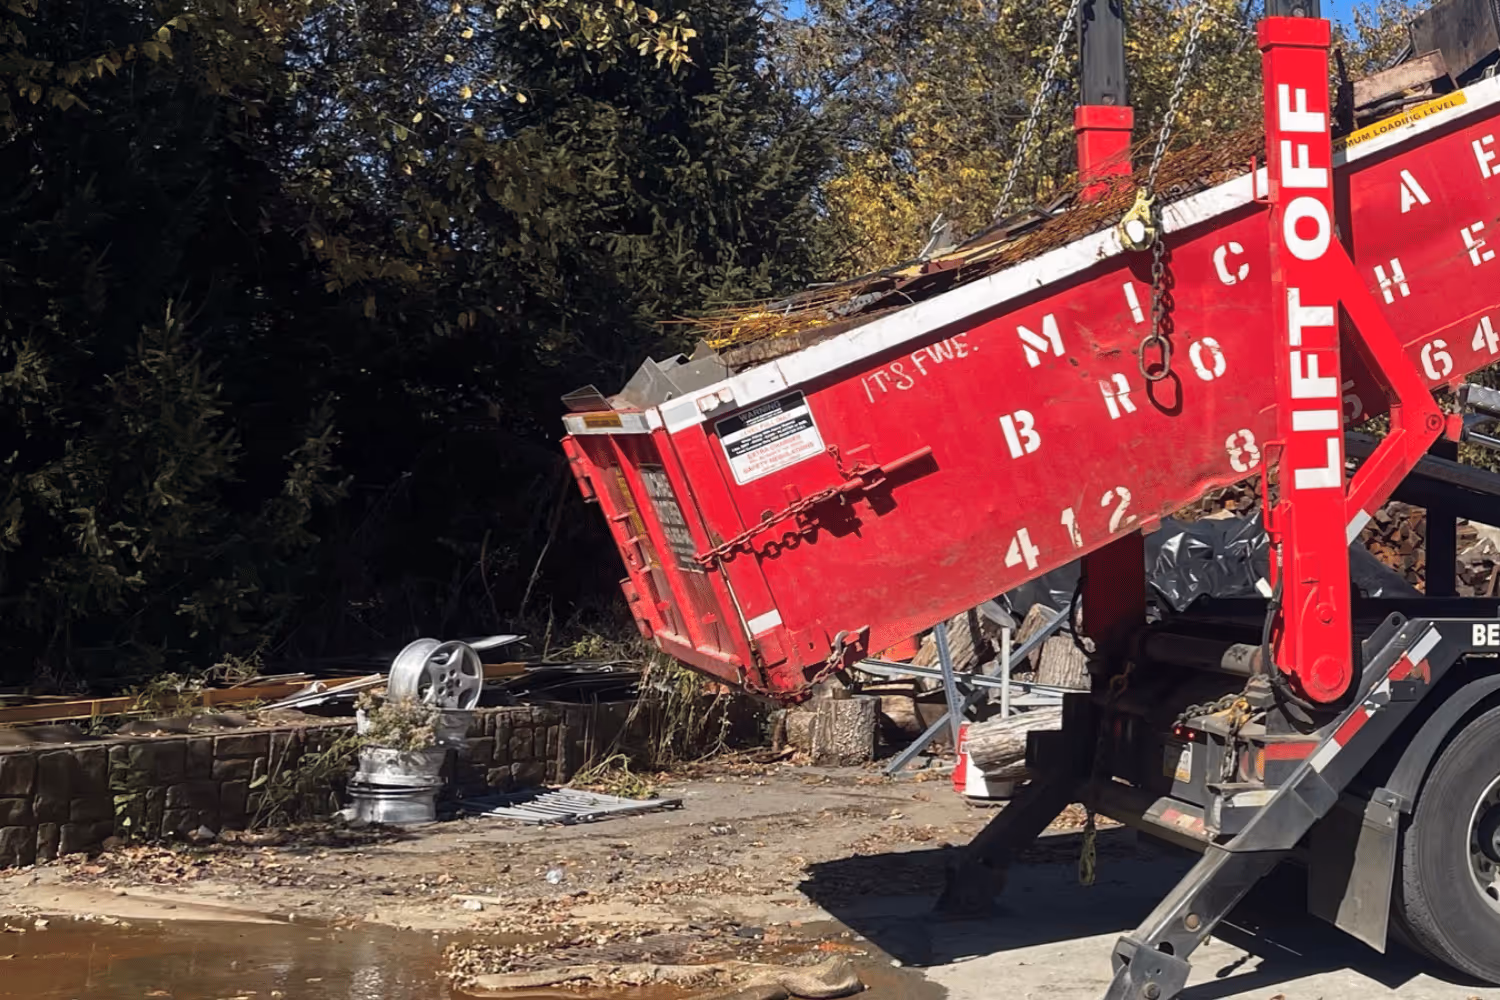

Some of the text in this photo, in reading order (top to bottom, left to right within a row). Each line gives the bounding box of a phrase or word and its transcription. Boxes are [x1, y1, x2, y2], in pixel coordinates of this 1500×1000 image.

[1373, 112, 1421, 137] LOADING
[1423, 100, 1457, 117] LEVEL
[1278, 84, 1341, 490] LIFT OFF
[1004, 487, 1136, 570] 412
